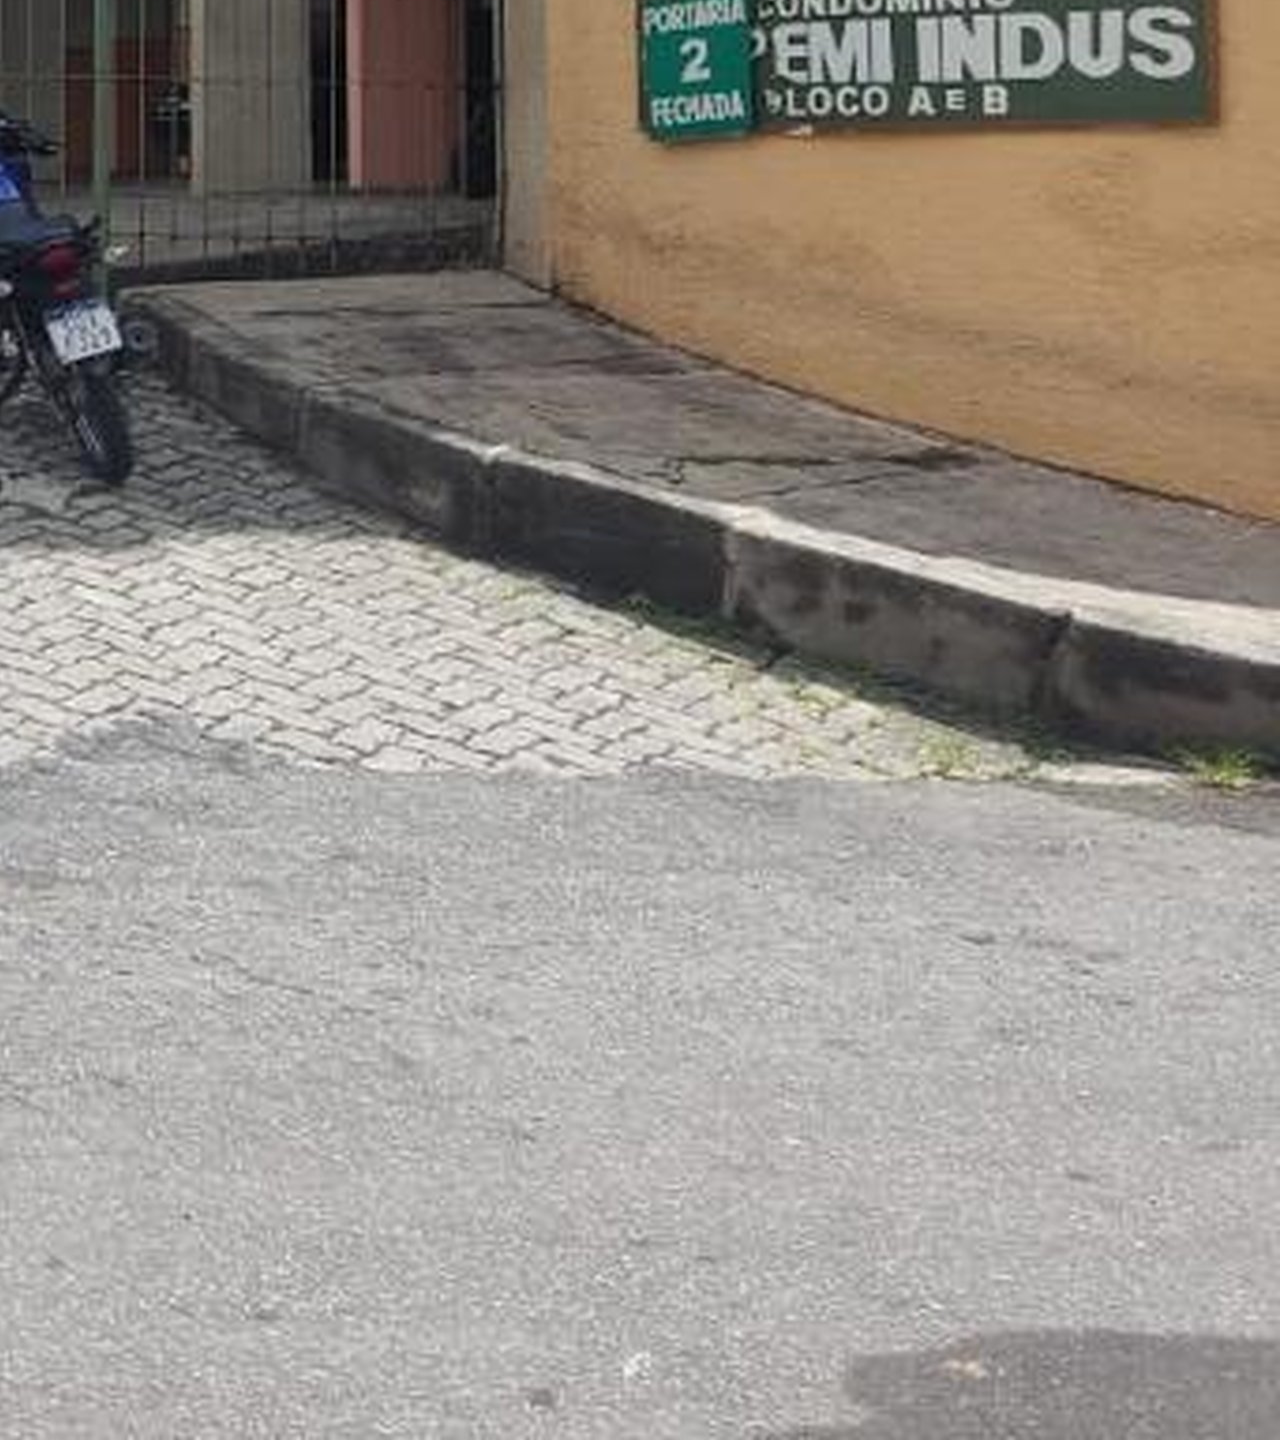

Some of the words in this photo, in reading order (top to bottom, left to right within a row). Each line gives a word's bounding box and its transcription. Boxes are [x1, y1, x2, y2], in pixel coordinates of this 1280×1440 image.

[680, 37, 711, 83] 2
[915, 4, 1195, 83] INDUS
[651, 90, 744, 127] FECHADA
[907, 85, 937, 116] A
[945, 88, 966, 110] E
[982, 83, 1008, 116] B
